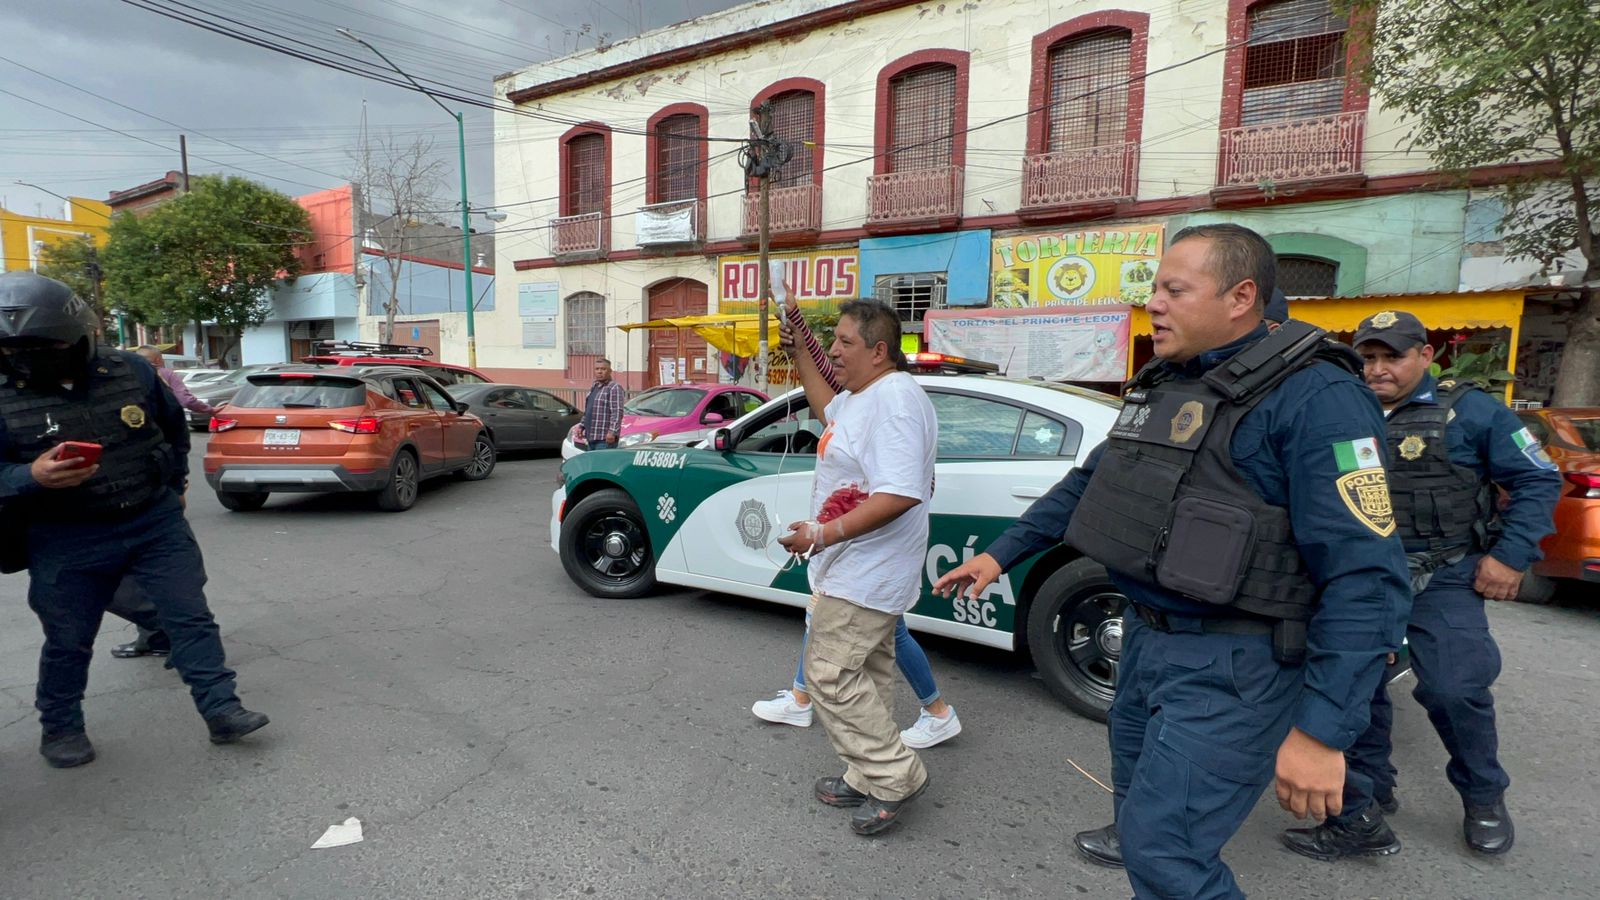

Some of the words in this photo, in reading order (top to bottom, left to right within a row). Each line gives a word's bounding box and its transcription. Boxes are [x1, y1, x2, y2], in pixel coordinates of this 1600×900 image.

[995, 229, 1158, 268] TORTERIA
[723, 257, 857, 299] ROULOS
[951, 319, 996, 327] TORTAS
[1022, 316, 1081, 325] PRINCIPE
[952, 597, 998, 628] SSC
